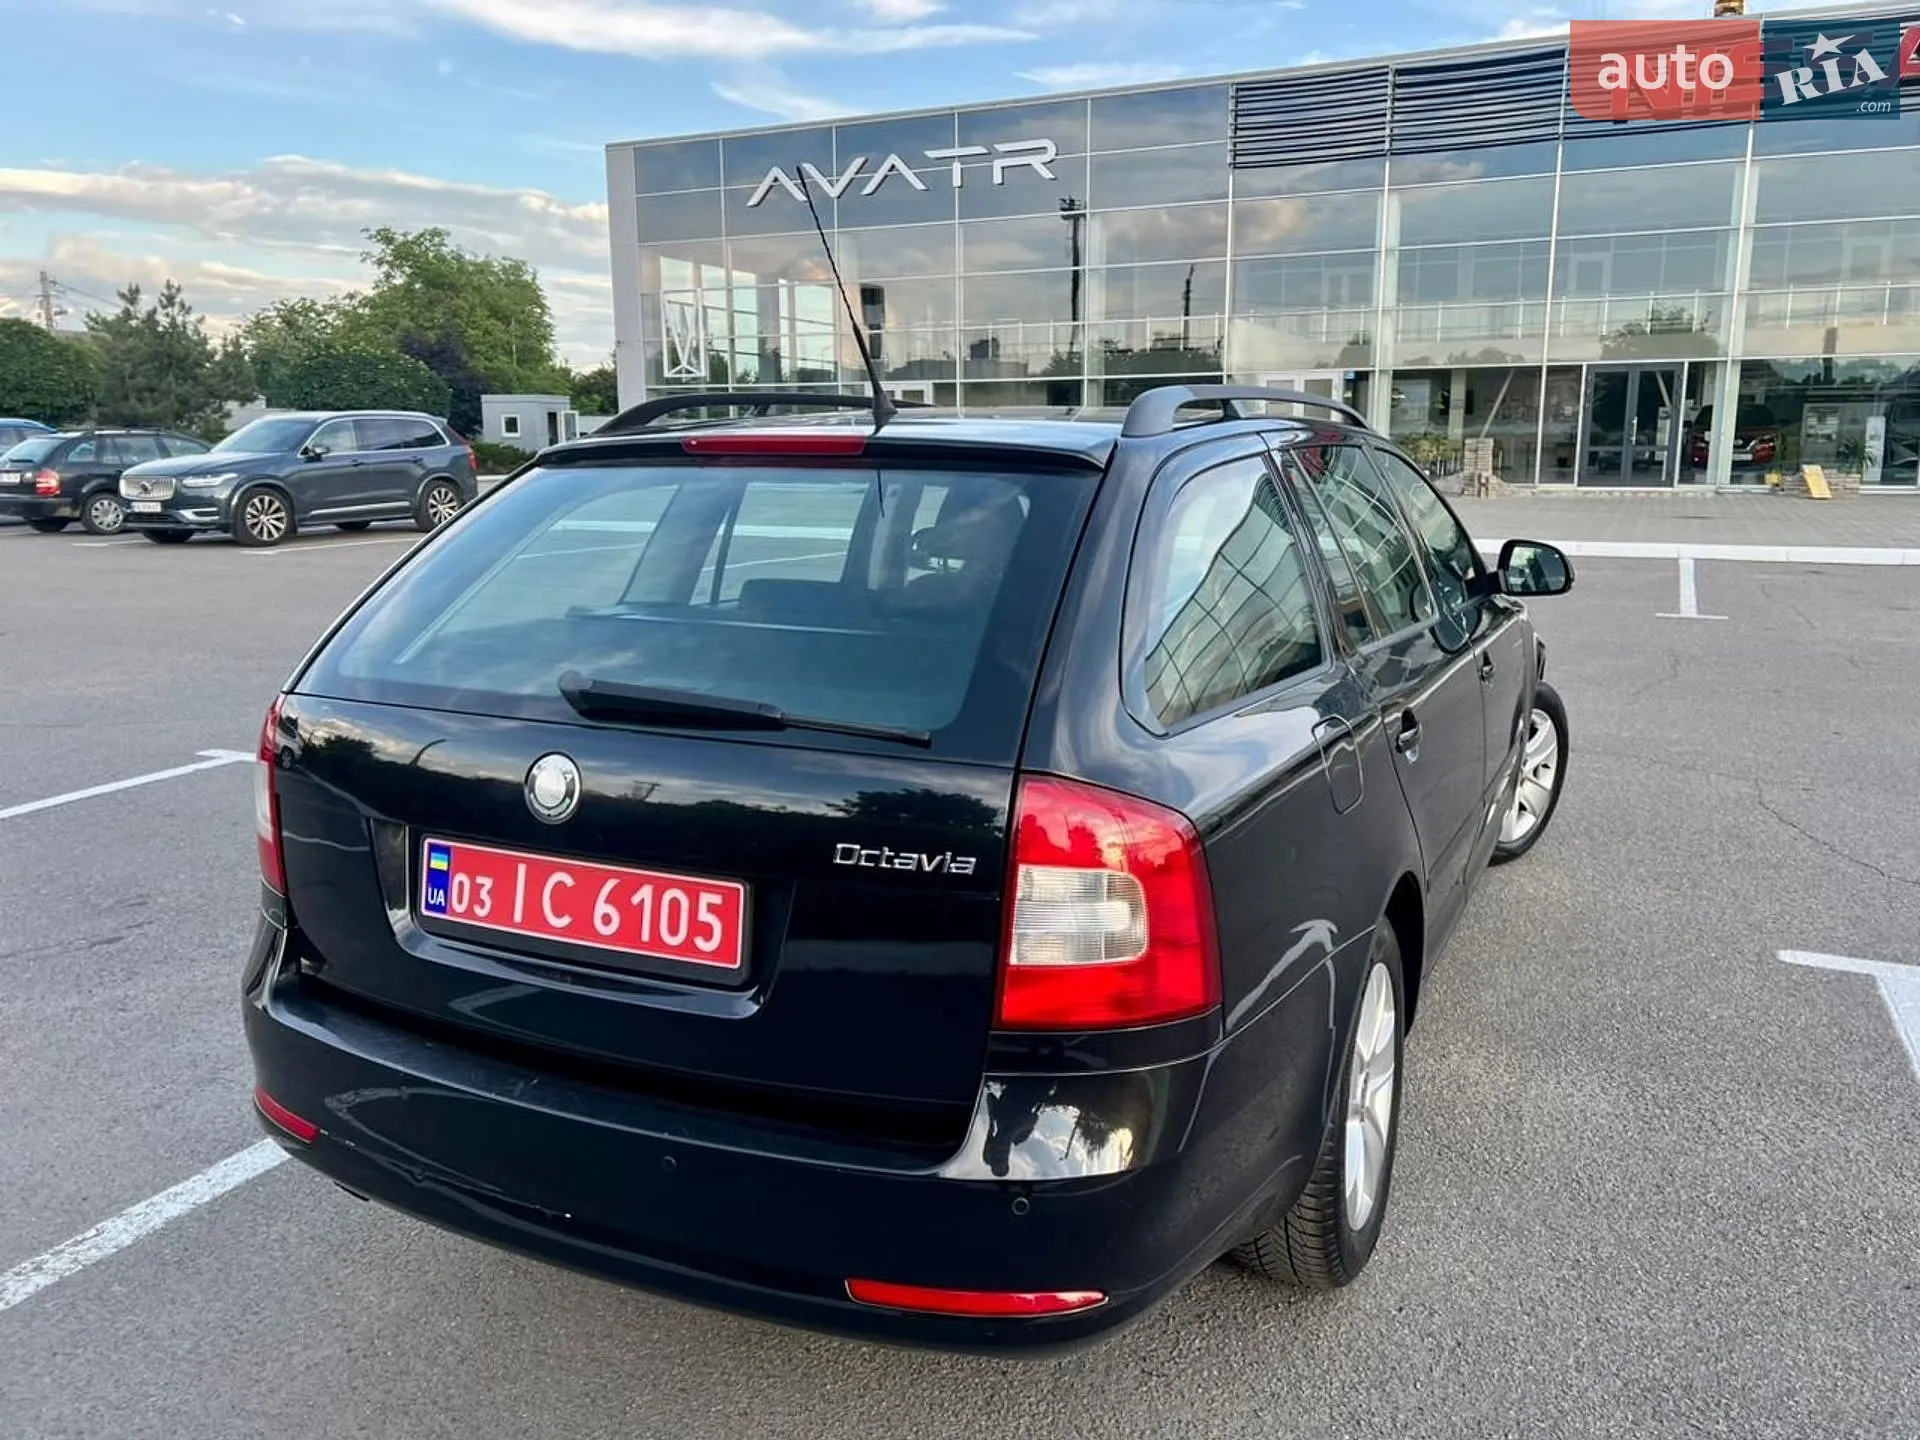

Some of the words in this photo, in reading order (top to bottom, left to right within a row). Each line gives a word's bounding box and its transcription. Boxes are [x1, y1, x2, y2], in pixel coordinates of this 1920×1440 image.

[746, 138, 1057, 207] AVATR
[832, 843, 977, 876] Octavia
[428, 886, 446, 906] UA
[593, 878, 723, 952] 6105
